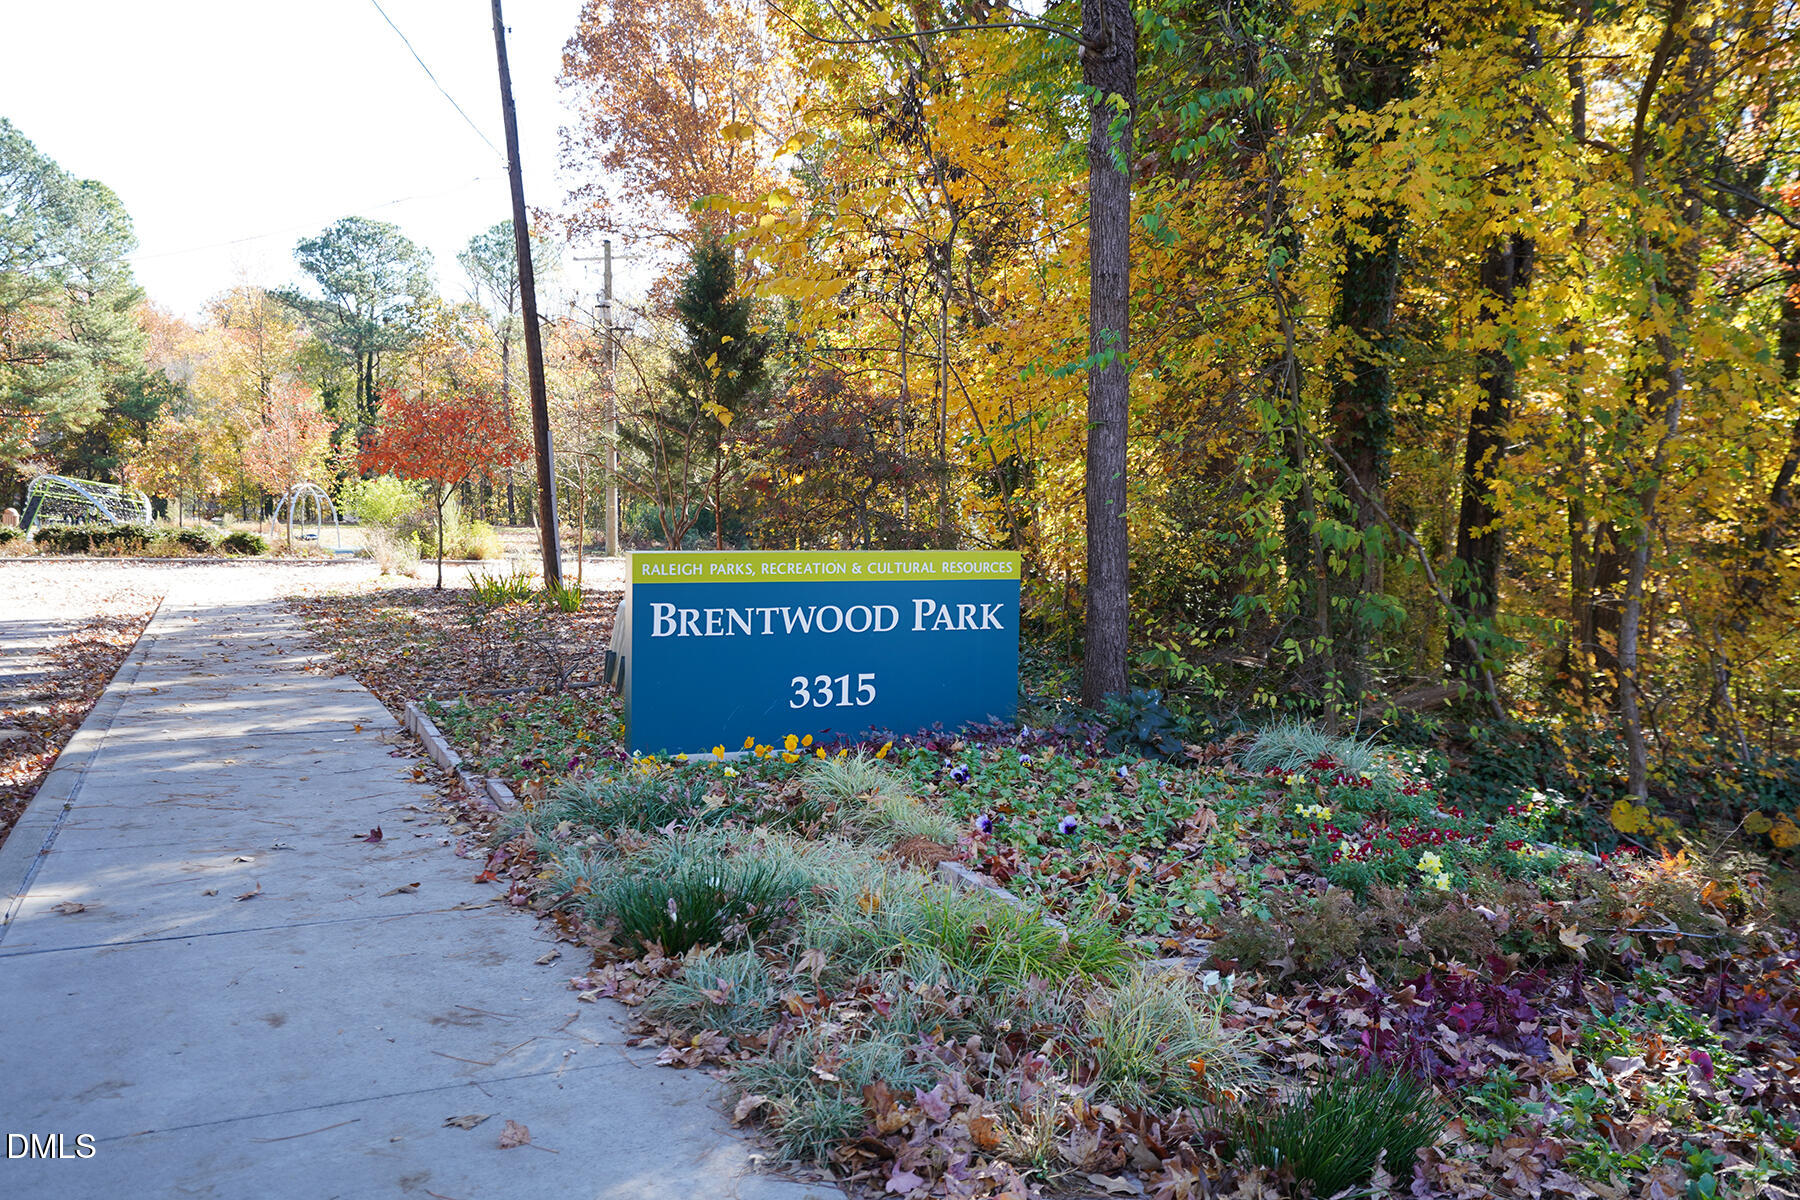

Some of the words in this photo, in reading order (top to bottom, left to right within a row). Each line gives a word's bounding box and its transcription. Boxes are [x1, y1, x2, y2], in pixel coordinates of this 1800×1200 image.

[641, 563, 703, 577] RALEIGH
[709, 563, 756, 577] PARKS,
[761, 562, 847, 575] RECREATION
[851, 562, 863, 575] &
[867, 561, 937, 575] CULTURAL
[942, 561, 1013, 574] RESOURCES
[789, 673, 876, 709] 3315
